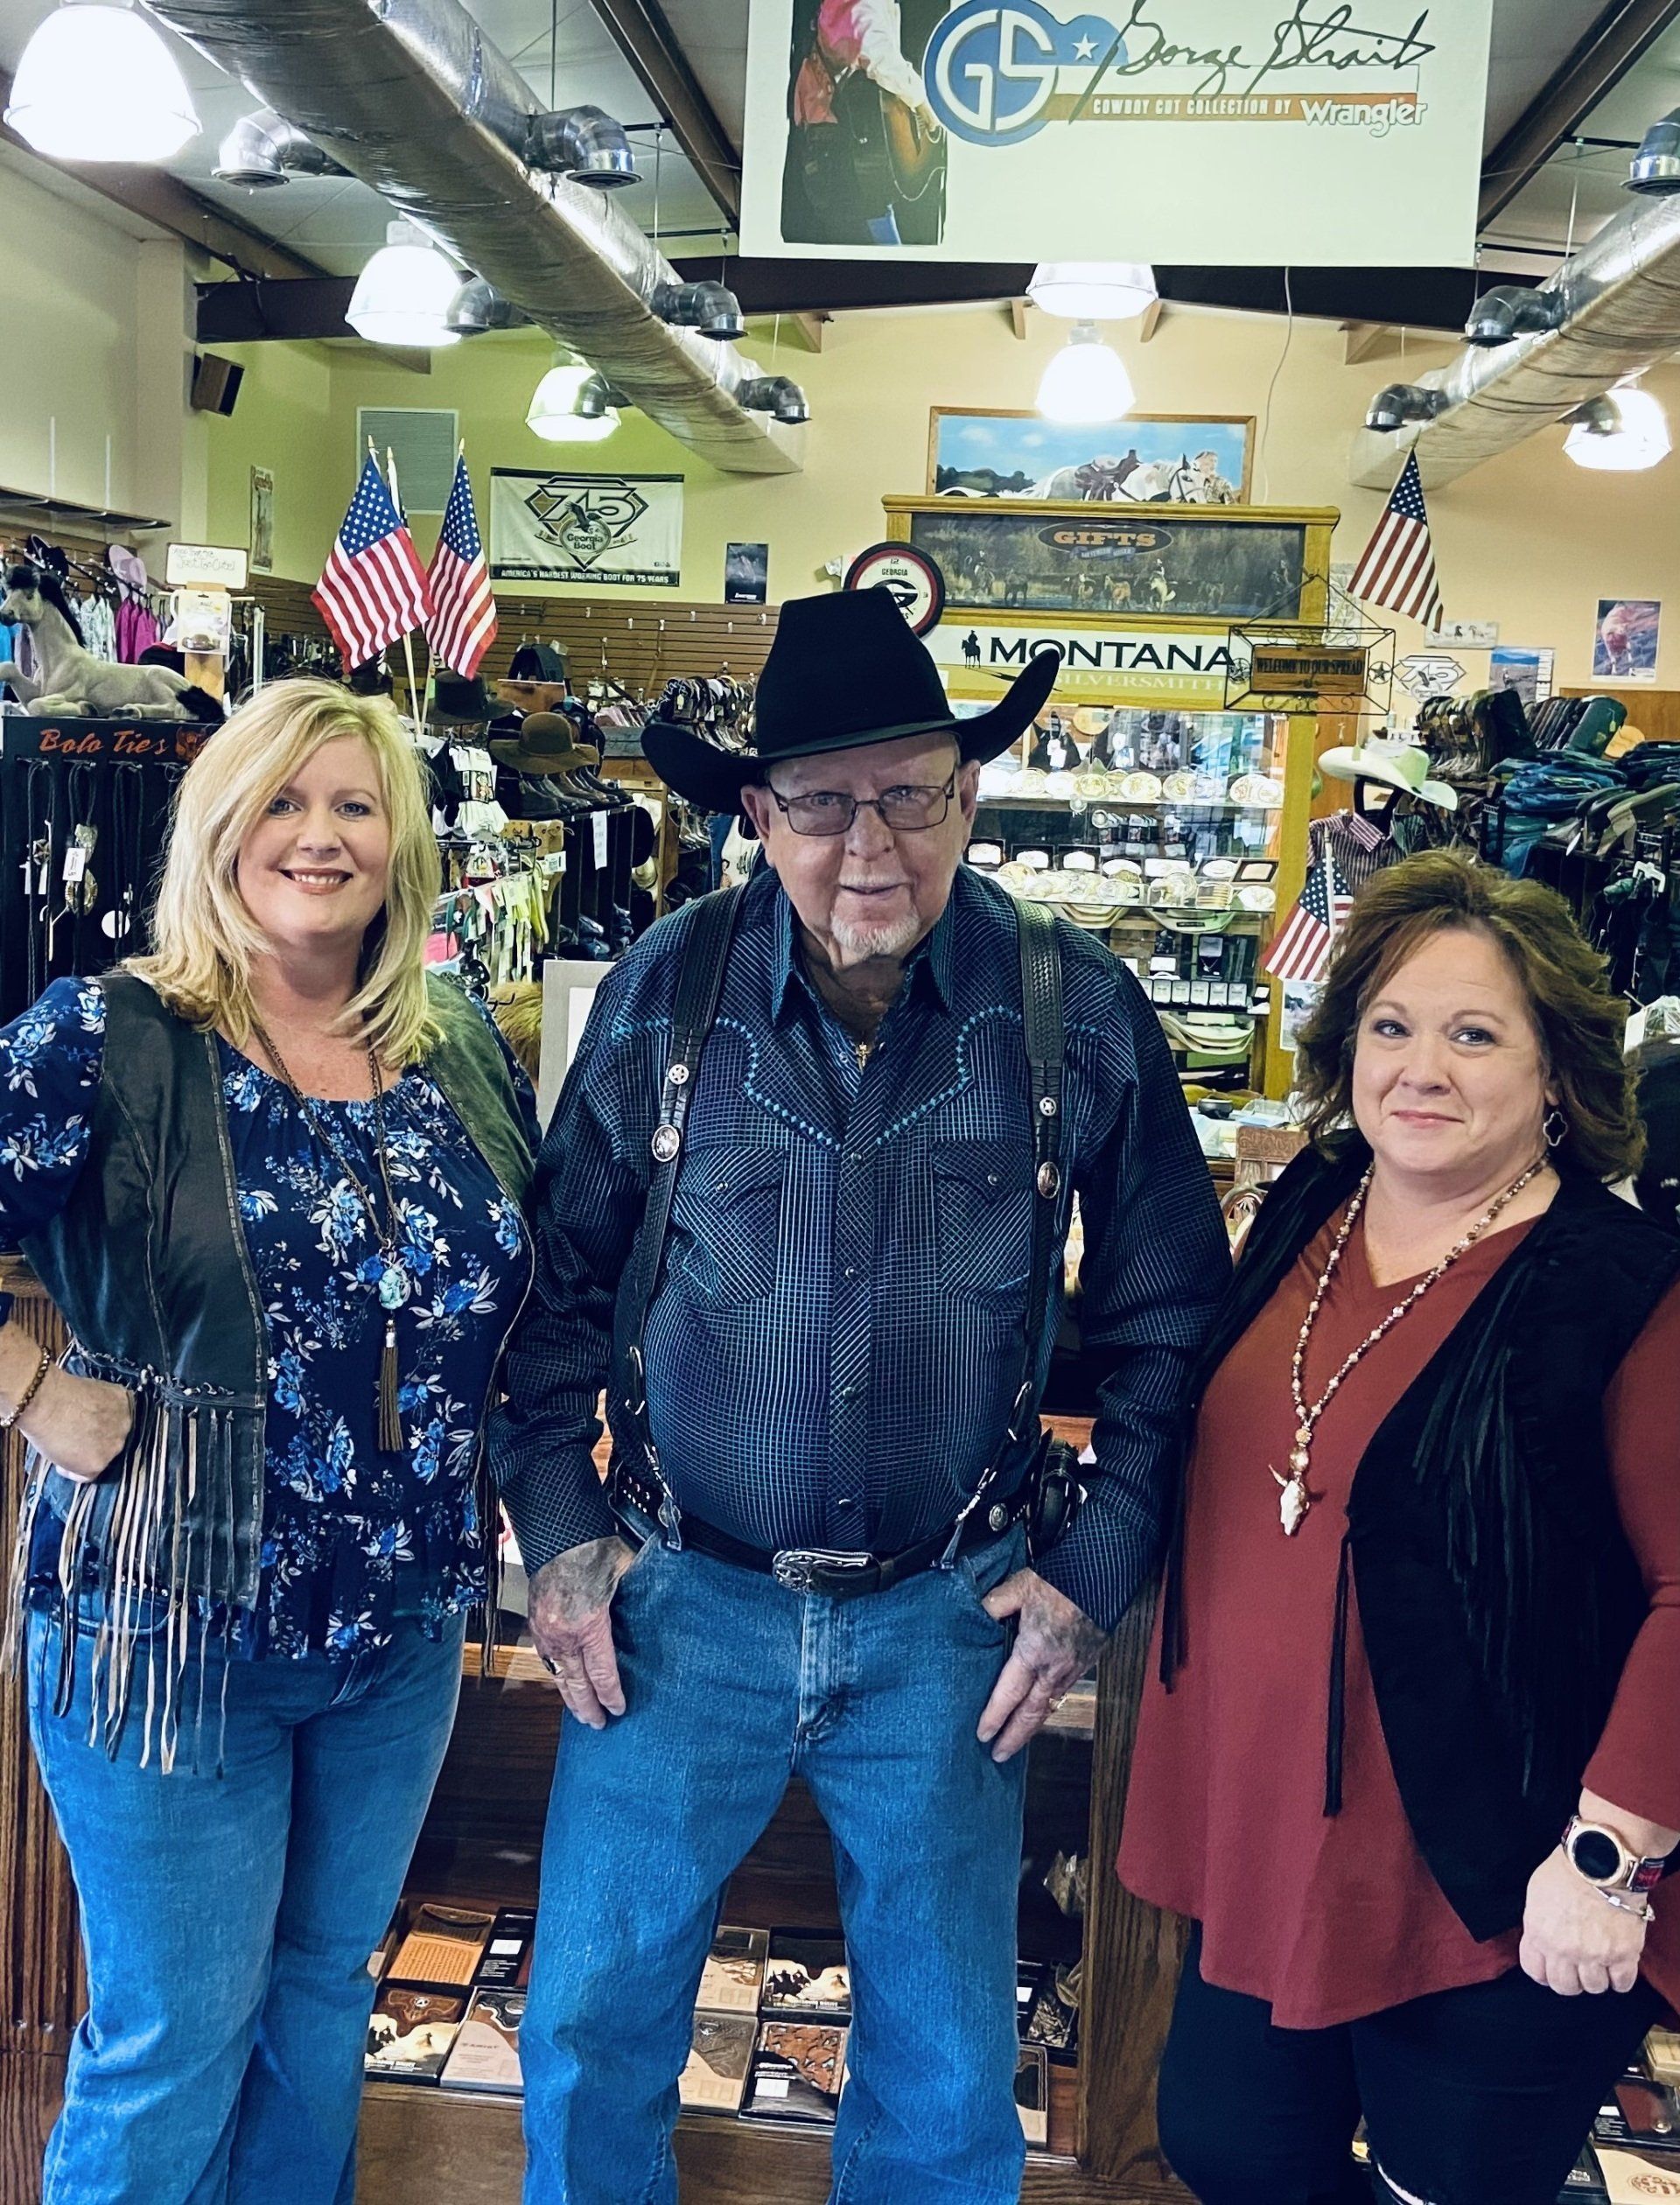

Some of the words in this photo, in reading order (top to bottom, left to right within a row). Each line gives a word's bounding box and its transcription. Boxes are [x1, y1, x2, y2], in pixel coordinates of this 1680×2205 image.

[1093, 98, 1151, 116] COWBOY
[1155, 98, 1180, 116] CUT
[1186, 98, 1269, 116] COLLECTION
[1274, 99, 1292, 116] BY
[1299, 97, 1428, 138] Wrangler
[536, 484, 638, 525] 75
[567, 533, 605, 544] Georgia
[573, 542, 596, 550] Boot
[1053, 530, 1157, 548] GIFTS
[500, 569, 538, 578] AMERICA'S
[539, 570, 569, 579] HARDEST
[570, 571, 602, 581] WORKING
[603, 572, 620, 581] BOOT
[621, 573, 635, 582] FOR
[647, 575, 669, 584] YEARS
[1398, 659, 1460, 683] 75
[39, 728, 104, 755] Bolo
[113, 729, 169, 755] Ties
